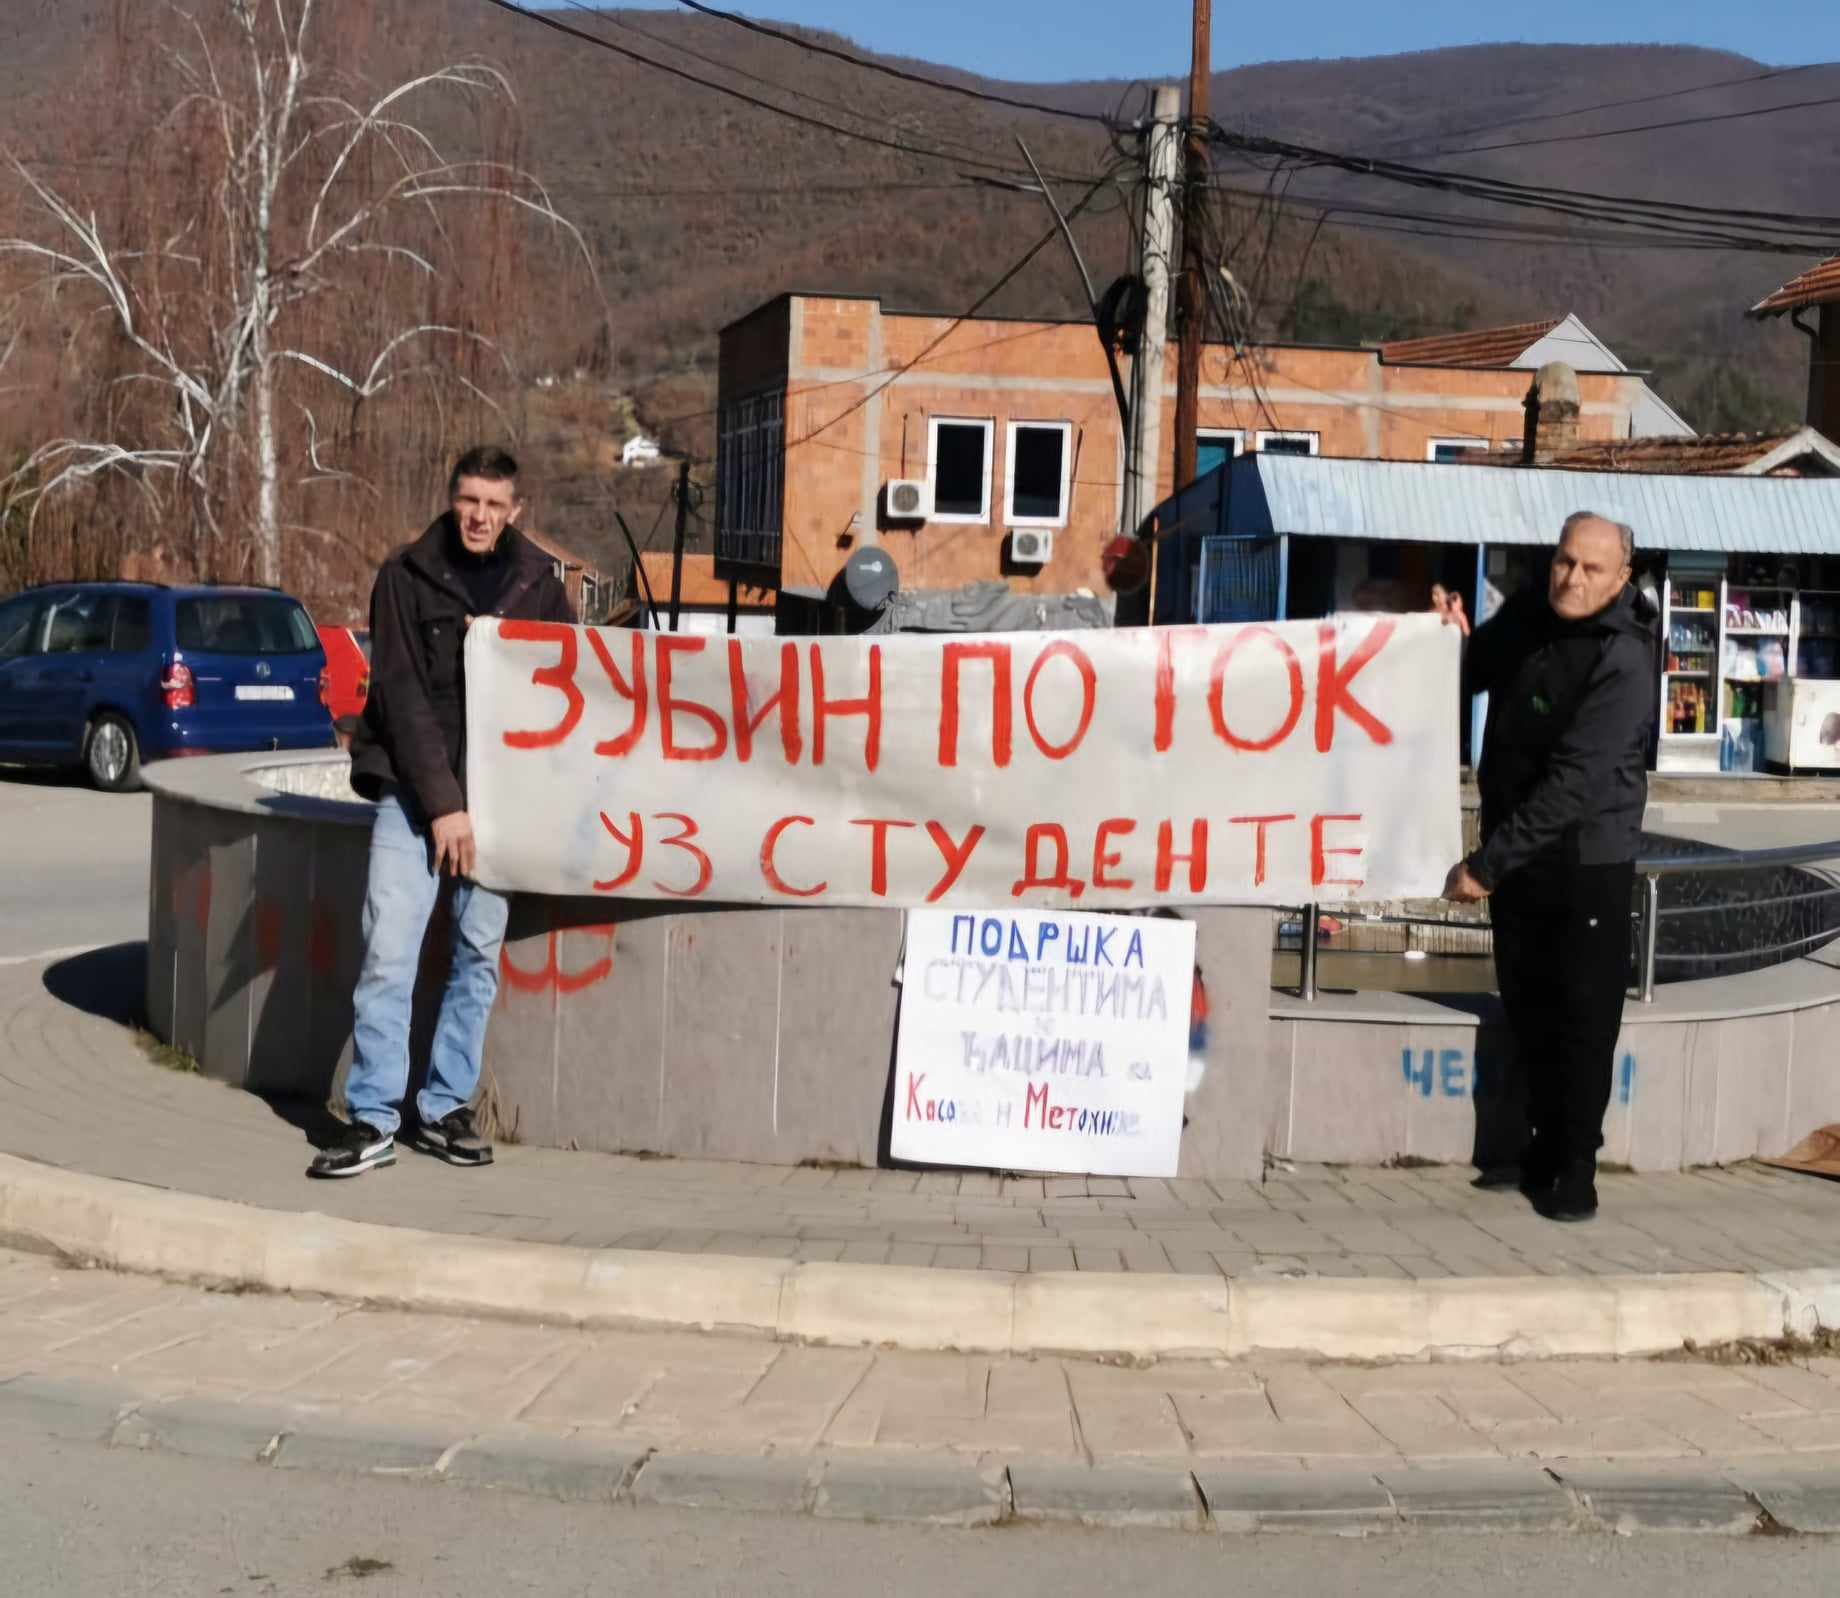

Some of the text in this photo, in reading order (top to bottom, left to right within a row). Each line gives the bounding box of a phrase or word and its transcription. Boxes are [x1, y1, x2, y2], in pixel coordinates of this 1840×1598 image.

[498, 618, 1397, 774] ЗУБИН ПОТОК
[593, 811, 1364, 903] УЗ СТУДЕНТЕ
[950, 914, 1145, 969] ПОДРШКА
